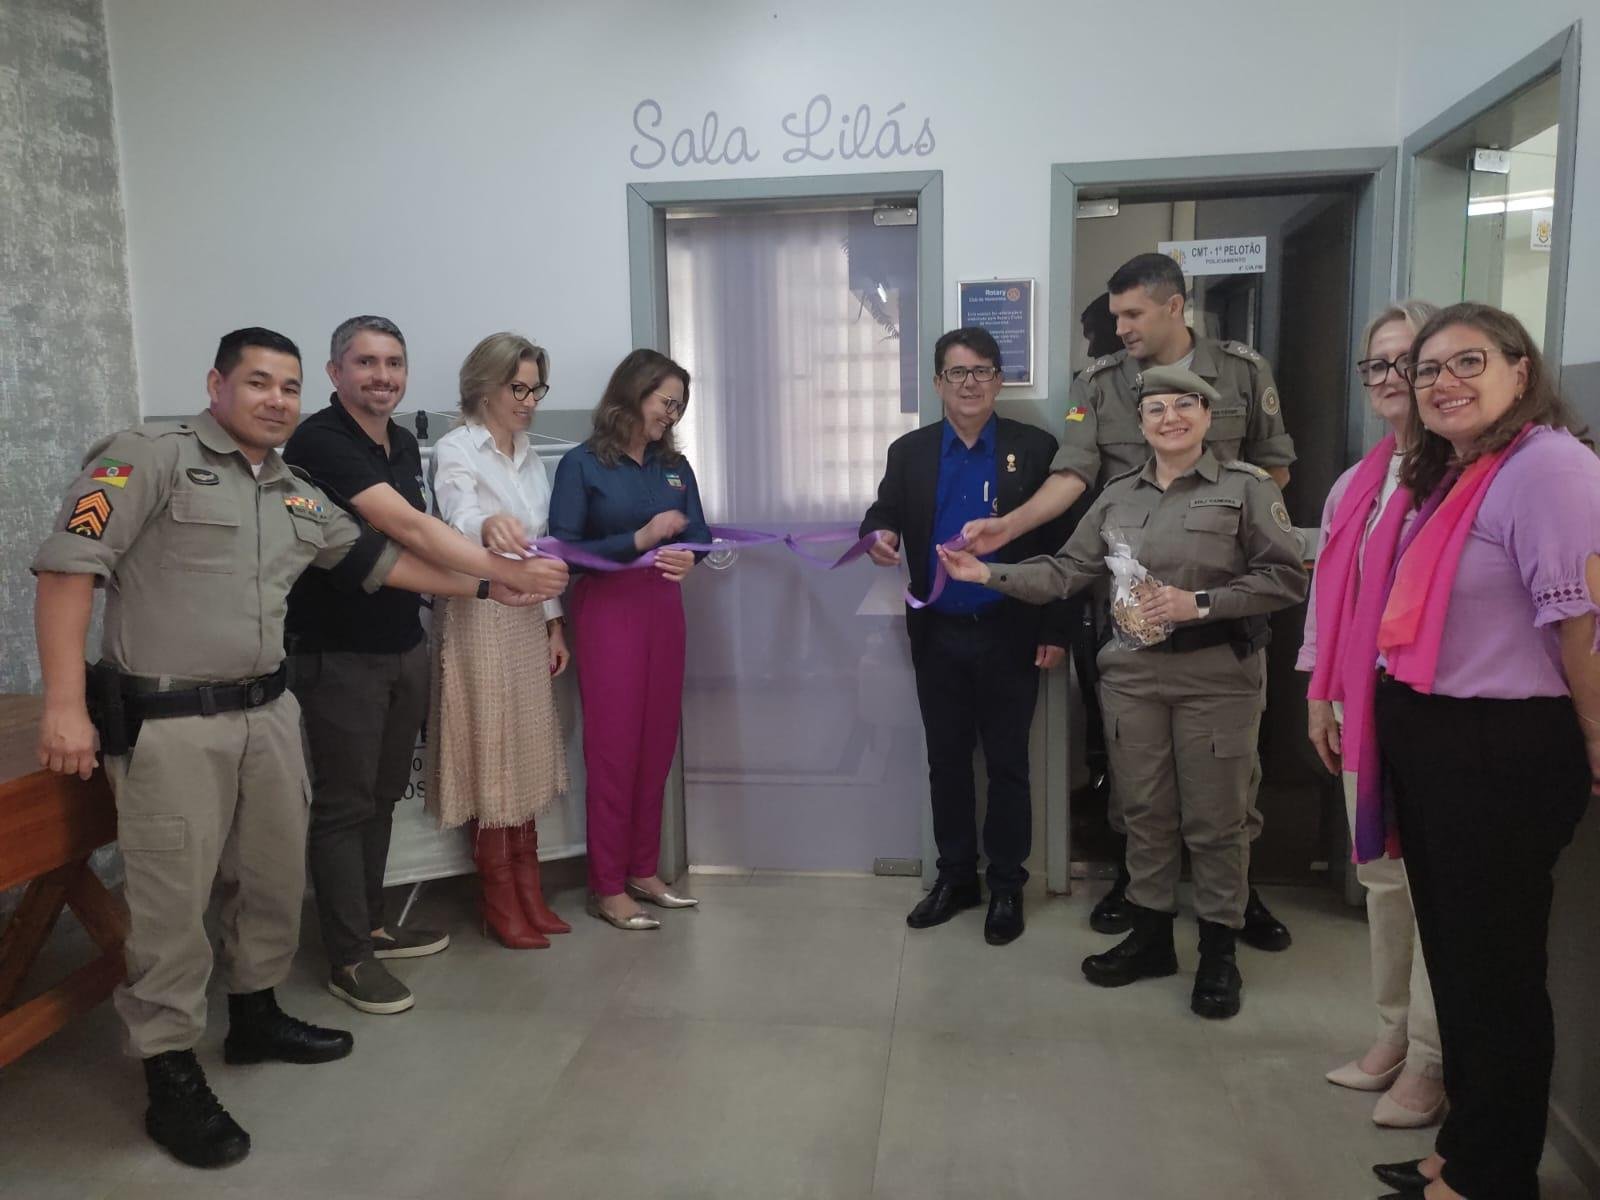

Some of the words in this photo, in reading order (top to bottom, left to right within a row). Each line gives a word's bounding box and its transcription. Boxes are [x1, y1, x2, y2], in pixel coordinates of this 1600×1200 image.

[630, 98, 760, 169] Sala
[781, 94, 936, 163] Lilás
[1192, 247, 1208, 257] CMT
[1224, 242, 1261, 255] PELOTÃO
